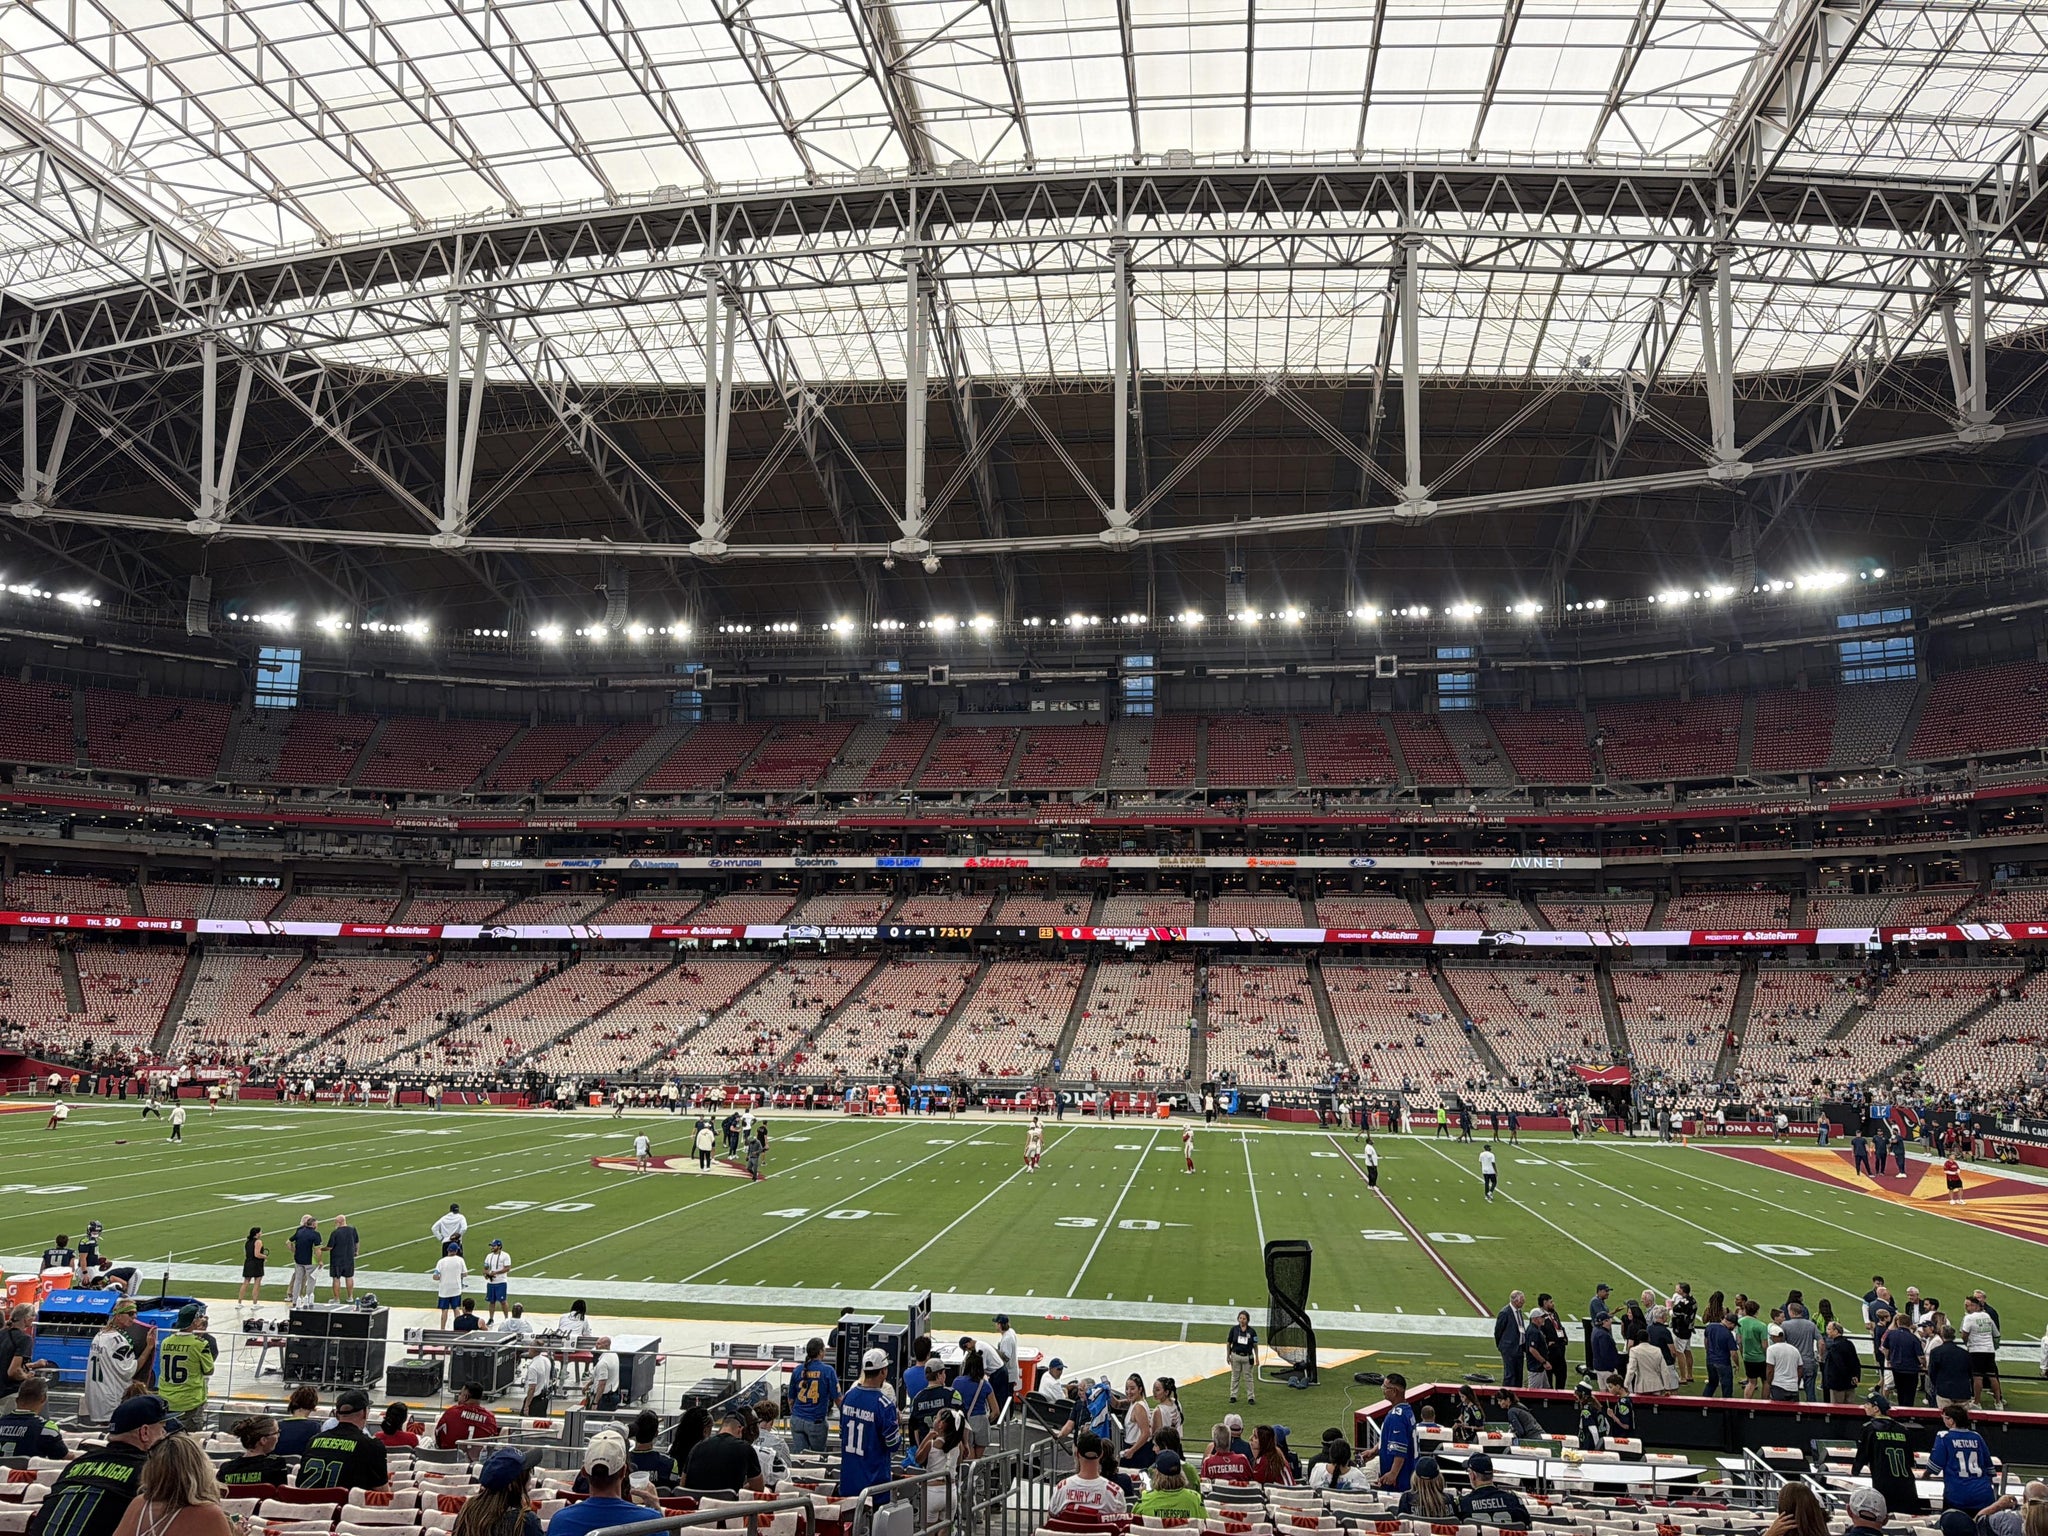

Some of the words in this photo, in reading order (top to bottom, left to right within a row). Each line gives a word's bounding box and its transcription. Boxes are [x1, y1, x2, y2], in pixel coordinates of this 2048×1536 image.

[1931, 794, 1947, 803] JIM
[1949, 791, 1976, 801] HART
[123, 804, 141, 812] ROY
[144, 807, 173, 815] GREEN
[1760, 806, 1785, 814] KURT
[1788, 804, 1830, 813] WARNER
[395, 820, 427, 828] CARSON
[428, 821, 459, 829] PALMER
[1400, 816, 1419, 824] DICK
[1420, 816, 1449, 824] (NIGHT
[1451, 816, 1481, 824] TRAIN)
[490, 860, 523, 868] BETMGM
[723, 859, 762, 867] HYUNDAI
[794, 858, 836, 868] Spectrum
[877, 858, 895, 867] BUD
[896, 858, 921, 867] LIGHT
[1353, 858, 1371, 867] Ford
[1510, 857, 1564, 868] AVNET
[20, 916, 51, 924] GAMES
[54, 915, 69, 925] 14
[86, 918, 101, 926] TKL
[104, 917, 121, 927] 30
[137, 920, 149, 929] QB
[150, 921, 168, 929] HITS
[170, 920, 183, 929] 13
[824, 926, 878, 935] SEAHAWKS
[889, 927, 899, 938] 0
[929, 927, 935, 938] 1
[939, 927, 973, 938] 73:17
[1041, 929, 1052, 938] 25
[1071, 927, 1081, 938] 0
[1092, 927, 1150, 938] CARDINALS
[2028, 926, 2048, 935] DL
[1892, 932, 1947, 941] SEASON
[1409, 1116, 1451, 1124] ARIZOA
[50, 1255, 63, 1267] 4
[8, 1284, 18, 1296] G
[43, 1280, 53, 1292] G
[162, 1343, 191, 1353] LOCKETT
[162, 1354, 189, 1385] 16
[797, 1380, 820, 1404] 24
[878, 1395, 892, 1408] 11
[460, 1410, 488, 1424] MURRAY
[467, 1425, 475, 1440] 1
[845, 1420, 865, 1457] 11
[1952, 1439, 1979, 1449] METCALF
[311, 1437, 358, 1453] WITHERSPOON
[1885, 1447, 1909, 1478] 11
[1955, 1450, 1983, 1478] 14
[300, 1457, 344, 1489] 21
[1207, 1463, 1244, 1475] FITZGERALD
[1066, 1488, 1089, 1502] HENRY
[1471, 1497, 1507, 1510] RUSSELL
[1153, 1508, 1191, 1519] WITHERSPOON
